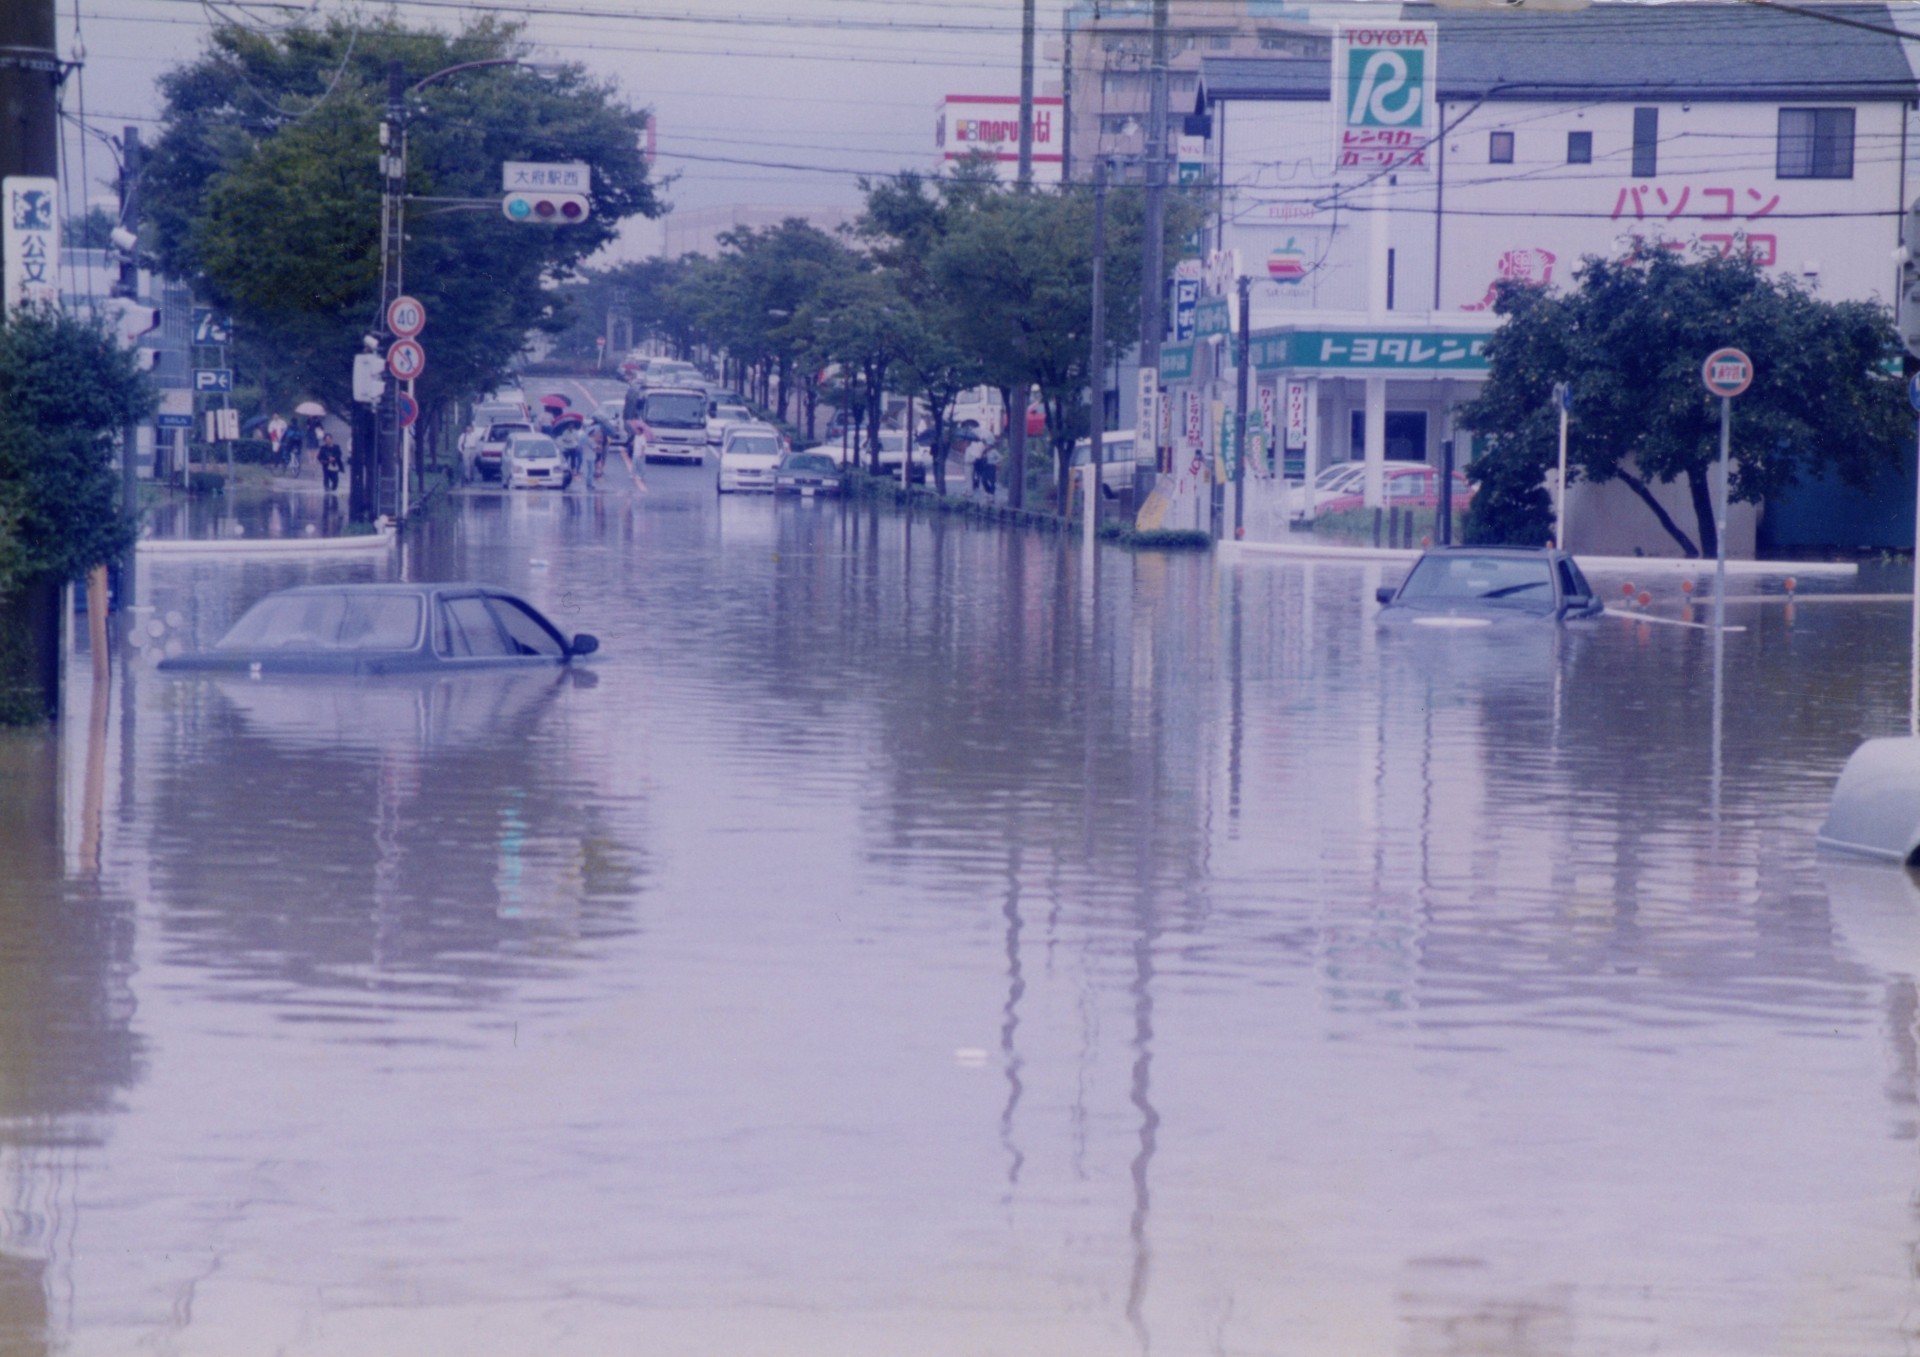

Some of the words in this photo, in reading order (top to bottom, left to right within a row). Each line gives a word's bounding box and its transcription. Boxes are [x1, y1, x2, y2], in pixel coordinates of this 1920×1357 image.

[1346, 29, 1428, 46] TOYOTA
[1343, 130, 1426, 145] レンタカー
[1342, 151, 1425, 167] カーリース
[514, 169, 578, 186] 大府駅西
[1611, 184, 1781, 221] パソコン
[1268, 205, 1314, 221] FUJITSU
[21, 234, 47, 284] 公文
[397, 308, 417, 327] 40
[197, 372, 217, 390] P
[1292, 386, 1302, 428] カーリース
